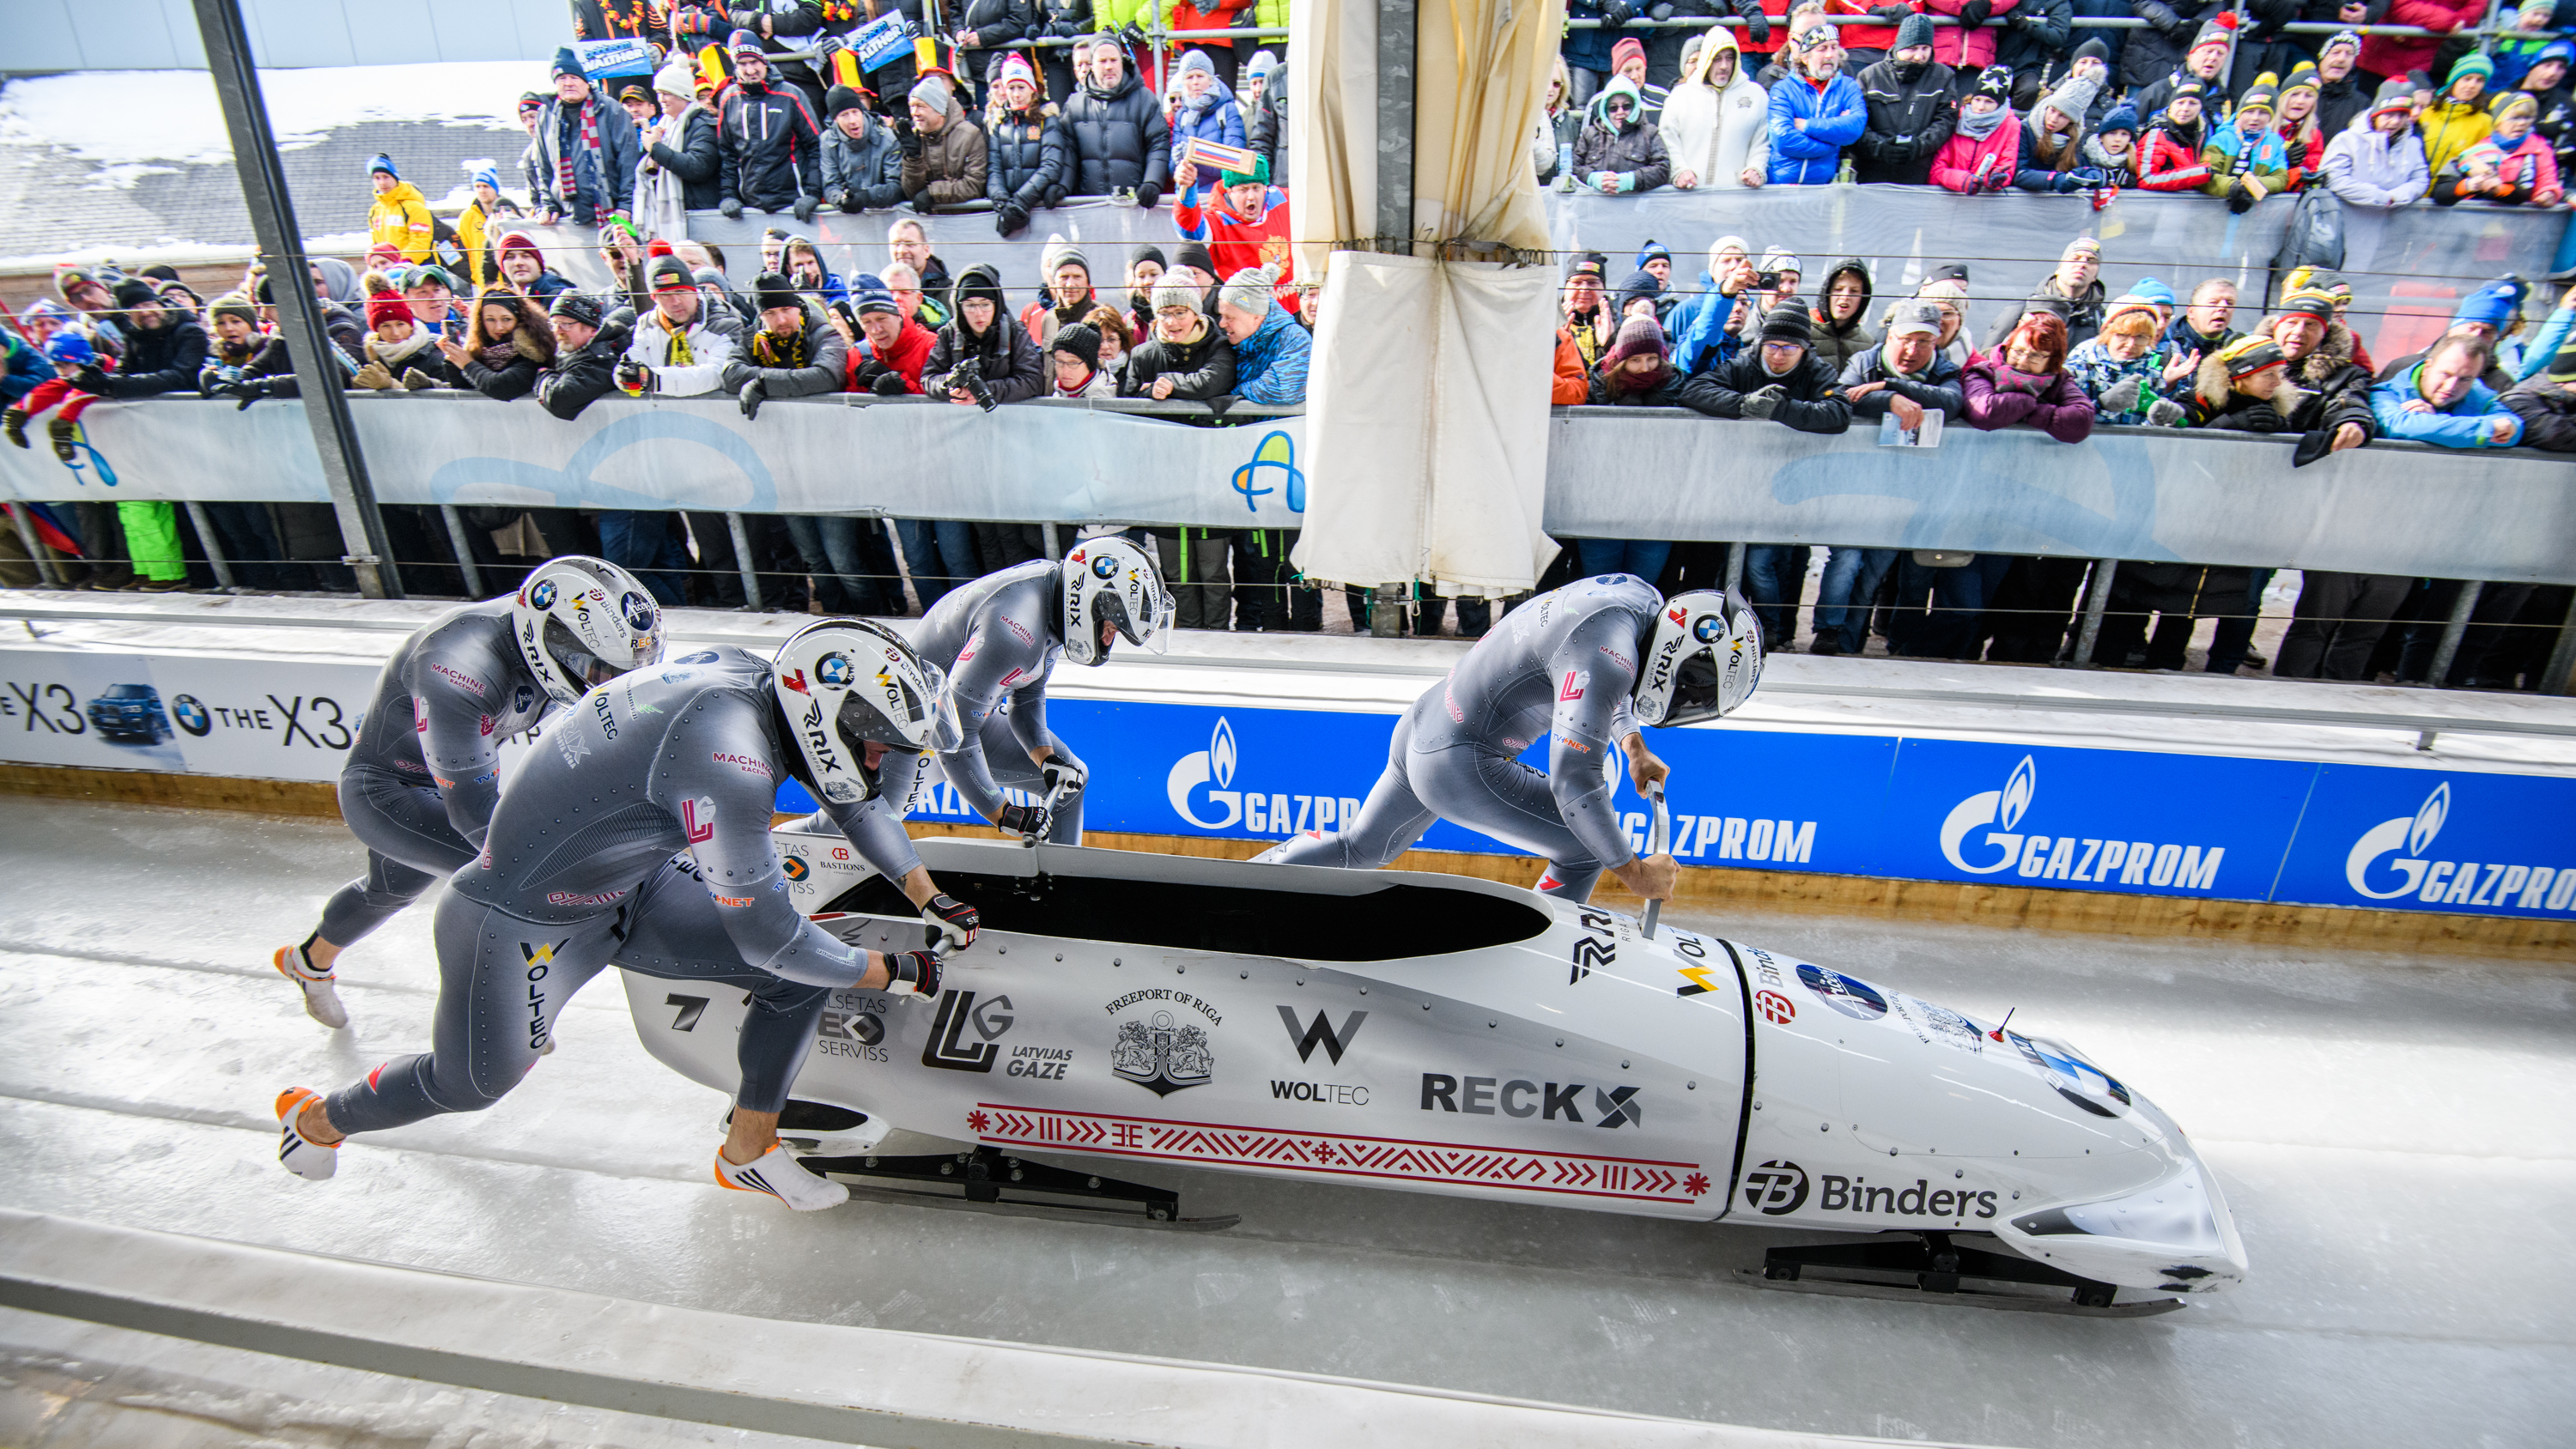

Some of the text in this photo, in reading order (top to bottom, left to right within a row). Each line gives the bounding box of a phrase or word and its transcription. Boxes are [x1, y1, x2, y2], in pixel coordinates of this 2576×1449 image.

[600, 600, 627, 639] Binders
[431, 663, 486, 692] MACHINE
[7, 682, 86, 735] X3
[215, 694, 352, 750] THE X3
[1036, 807, 1045, 824] SEIZ
[1245, 792, 1361, 834] GAZPR
[820, 861, 866, 871] BASTIONS
[2018, 835, 2226, 889] GAZPROM
[2418, 860, 2576, 911] GAZPRO
[519, 937, 573, 1050] WOLTEC
[1104, 989, 1224, 1028] FREEPORT OF RIGA
[818, 1040, 889, 1063] SERVISS
[1005, 1058, 1068, 1081] GĀZE
[1012, 1046, 1073, 1062] LATVIJAS
[1270, 1080, 1370, 1106] WOLTEC
[1420, 1072, 1587, 1123] RECK
[1820, 1174, 1998, 1219] Binders
